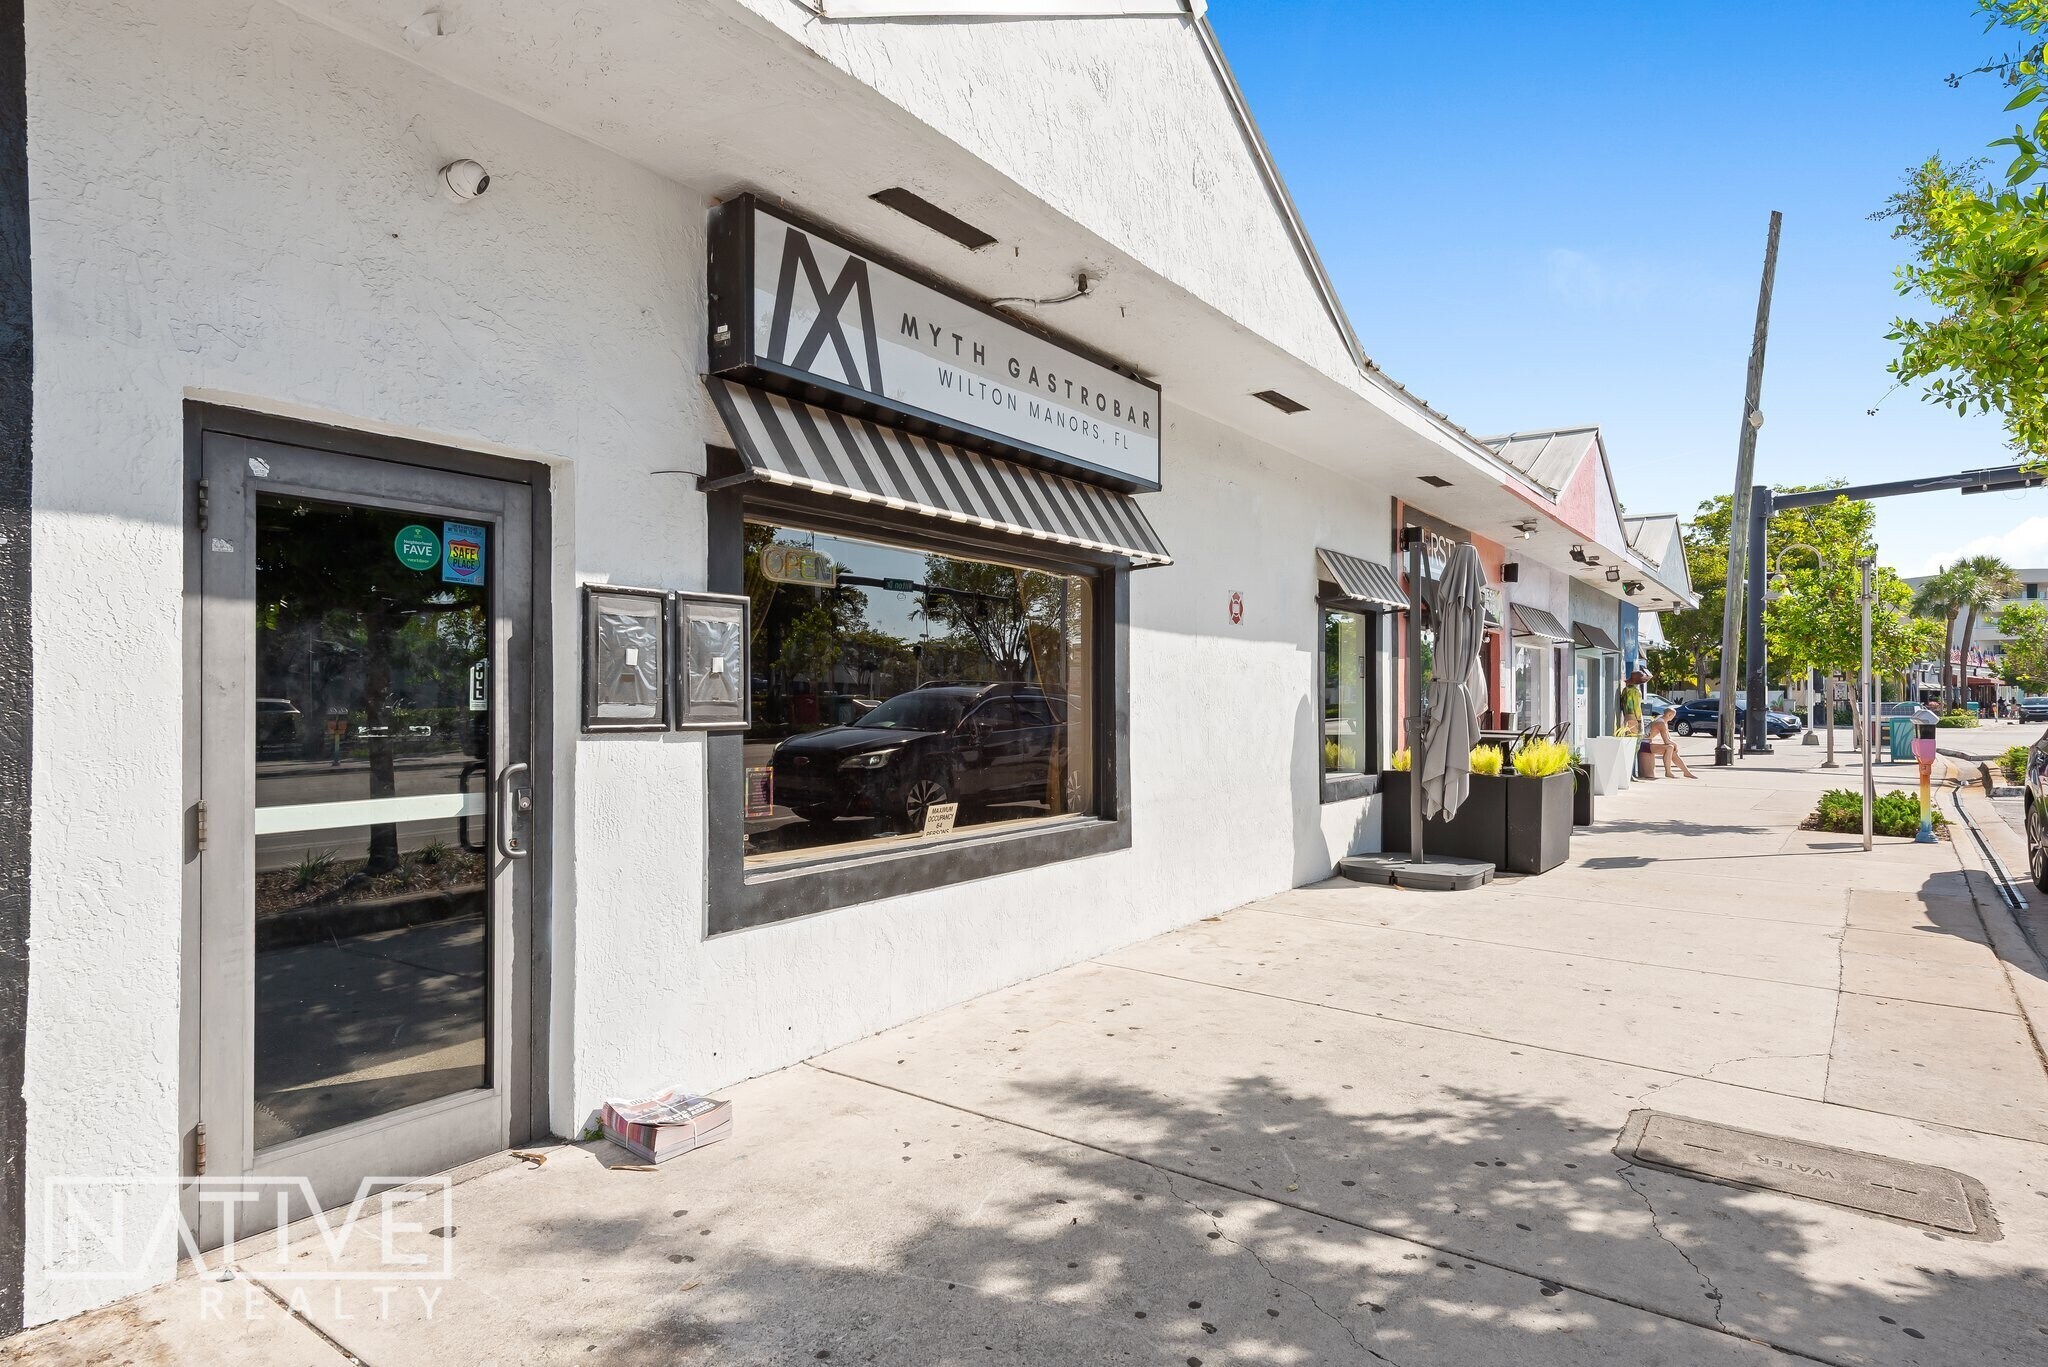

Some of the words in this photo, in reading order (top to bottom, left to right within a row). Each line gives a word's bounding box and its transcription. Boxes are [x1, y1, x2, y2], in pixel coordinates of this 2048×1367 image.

[900, 312, 986, 366] MYTH
[1007, 357, 1151, 430] GASTROBAR
[938, 366, 1017, 412] WILTON
[1028, 401, 1106, 445] MANORS,
[1114, 431, 1129, 450] FL
[403, 544, 433, 557] FAVE
[453, 546, 476, 560] SAFE
[452, 558, 476, 570] PLACE
[766, 550, 832, 580] OPEN
[475, 662, 483, 698] PULL
[928, 813, 954, 822] OCCUPANCY
[1754, 1154, 1835, 1179] WATER
